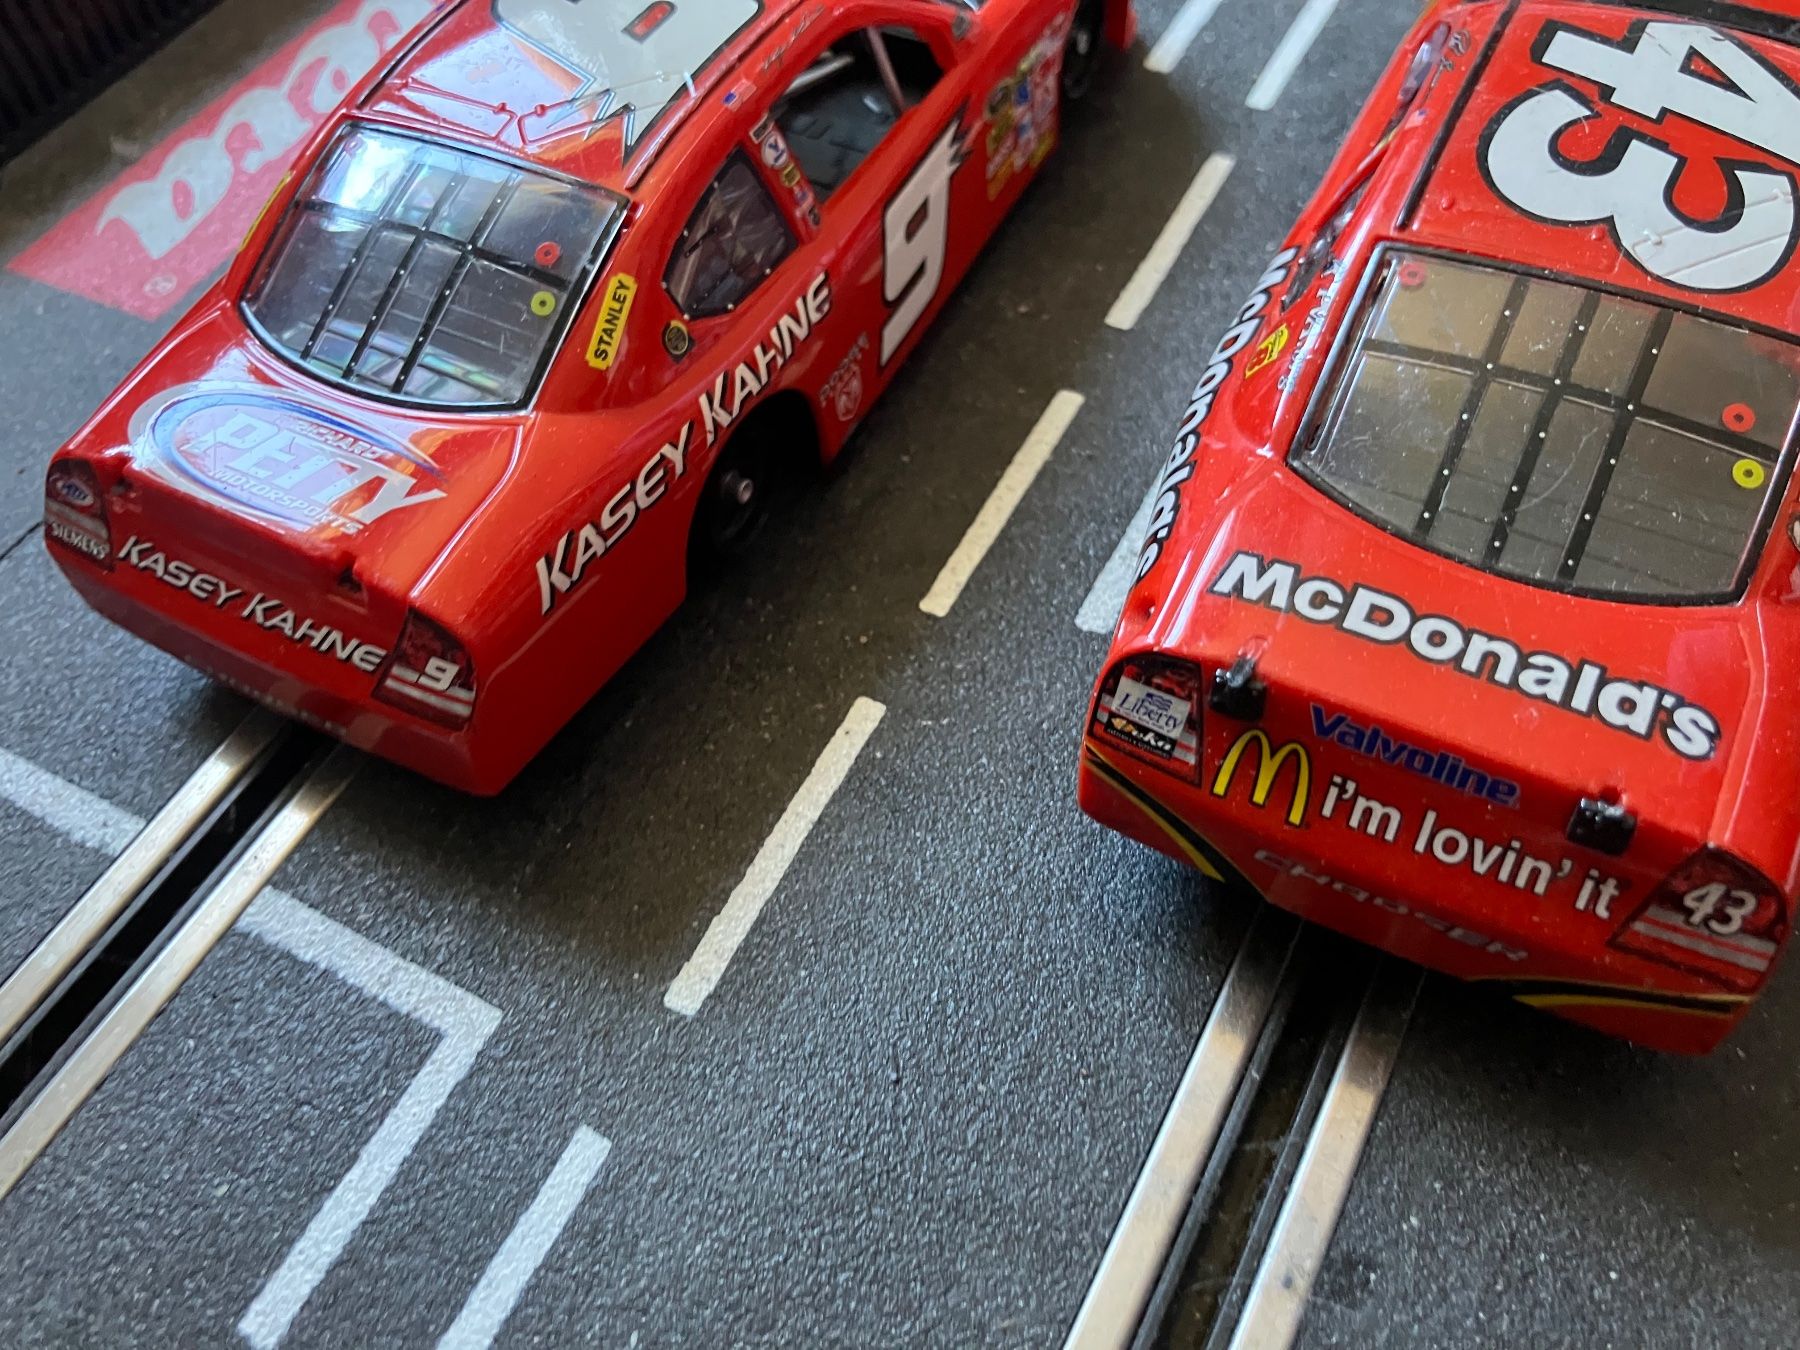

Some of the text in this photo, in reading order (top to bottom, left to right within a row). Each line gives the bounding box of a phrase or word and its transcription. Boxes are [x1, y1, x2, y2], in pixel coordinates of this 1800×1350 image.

[1478, 18, 1800, 294] 43
[880, 115, 962, 368] 9
[593, 279, 634, 362] STANLEY
[179, 411, 448, 526] PETTY
[208, 468, 365, 535] MOTORSPORTS
[534, 271, 832, 617] KASEY KAHNE
[117, 535, 389, 673] KASEY KAHNE
[1208, 550, 1721, 761] McDonald's
[421, 656, 460, 693] 9
[1309, 702, 1521, 808] Valvoline
[1320, 774, 1621, 921] i'm lovin' it
[1682, 880, 1758, 936] 43
